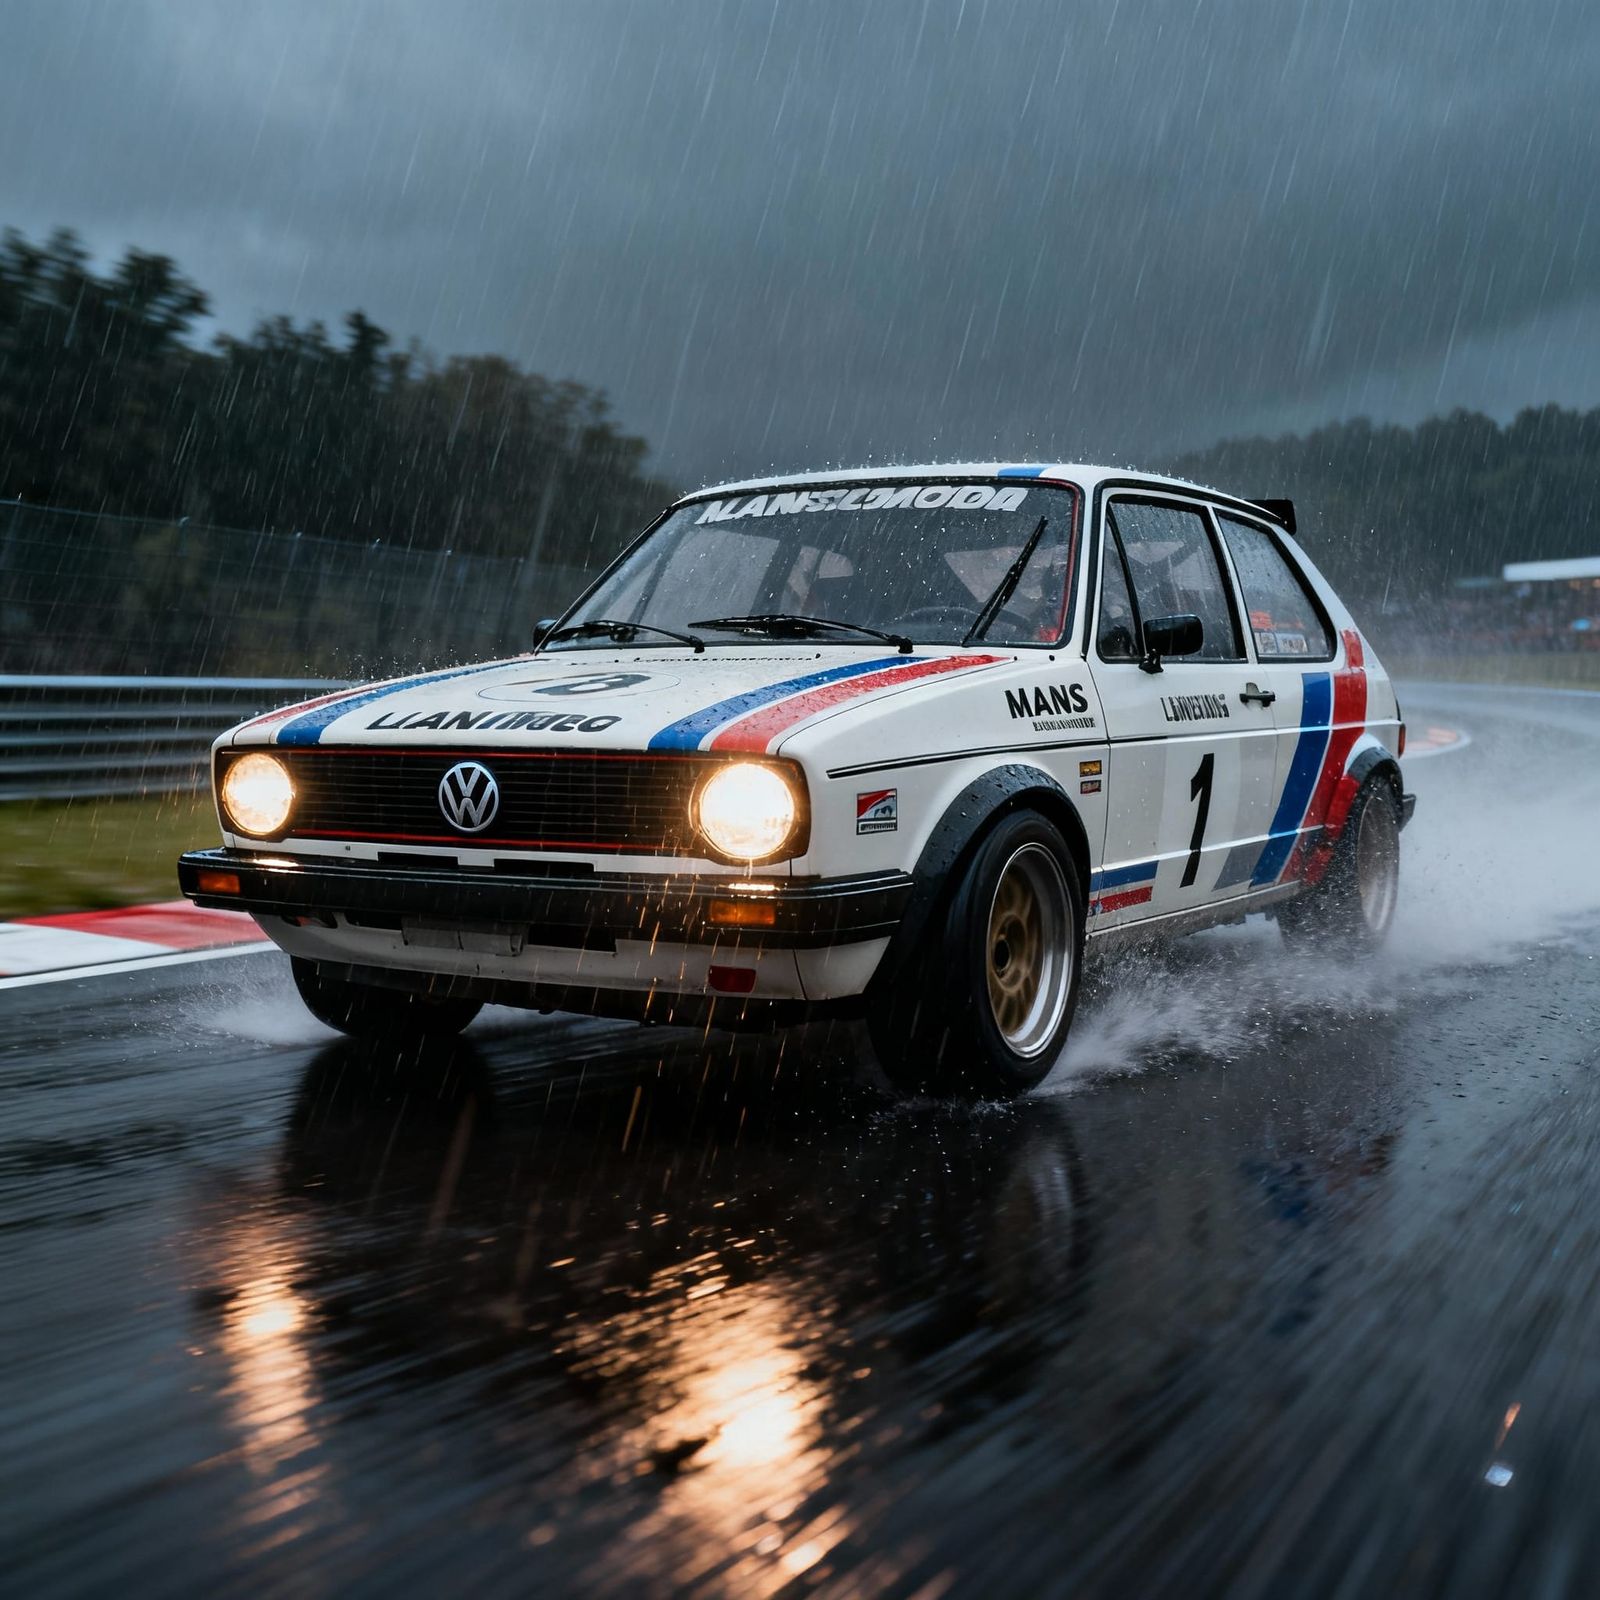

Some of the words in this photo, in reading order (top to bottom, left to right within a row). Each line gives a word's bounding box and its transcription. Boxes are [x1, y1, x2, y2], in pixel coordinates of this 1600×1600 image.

[1004, 683, 1089, 719] MANS
[441, 764, 497, 829] VW
[1179, 752, 1215, 888] 1
